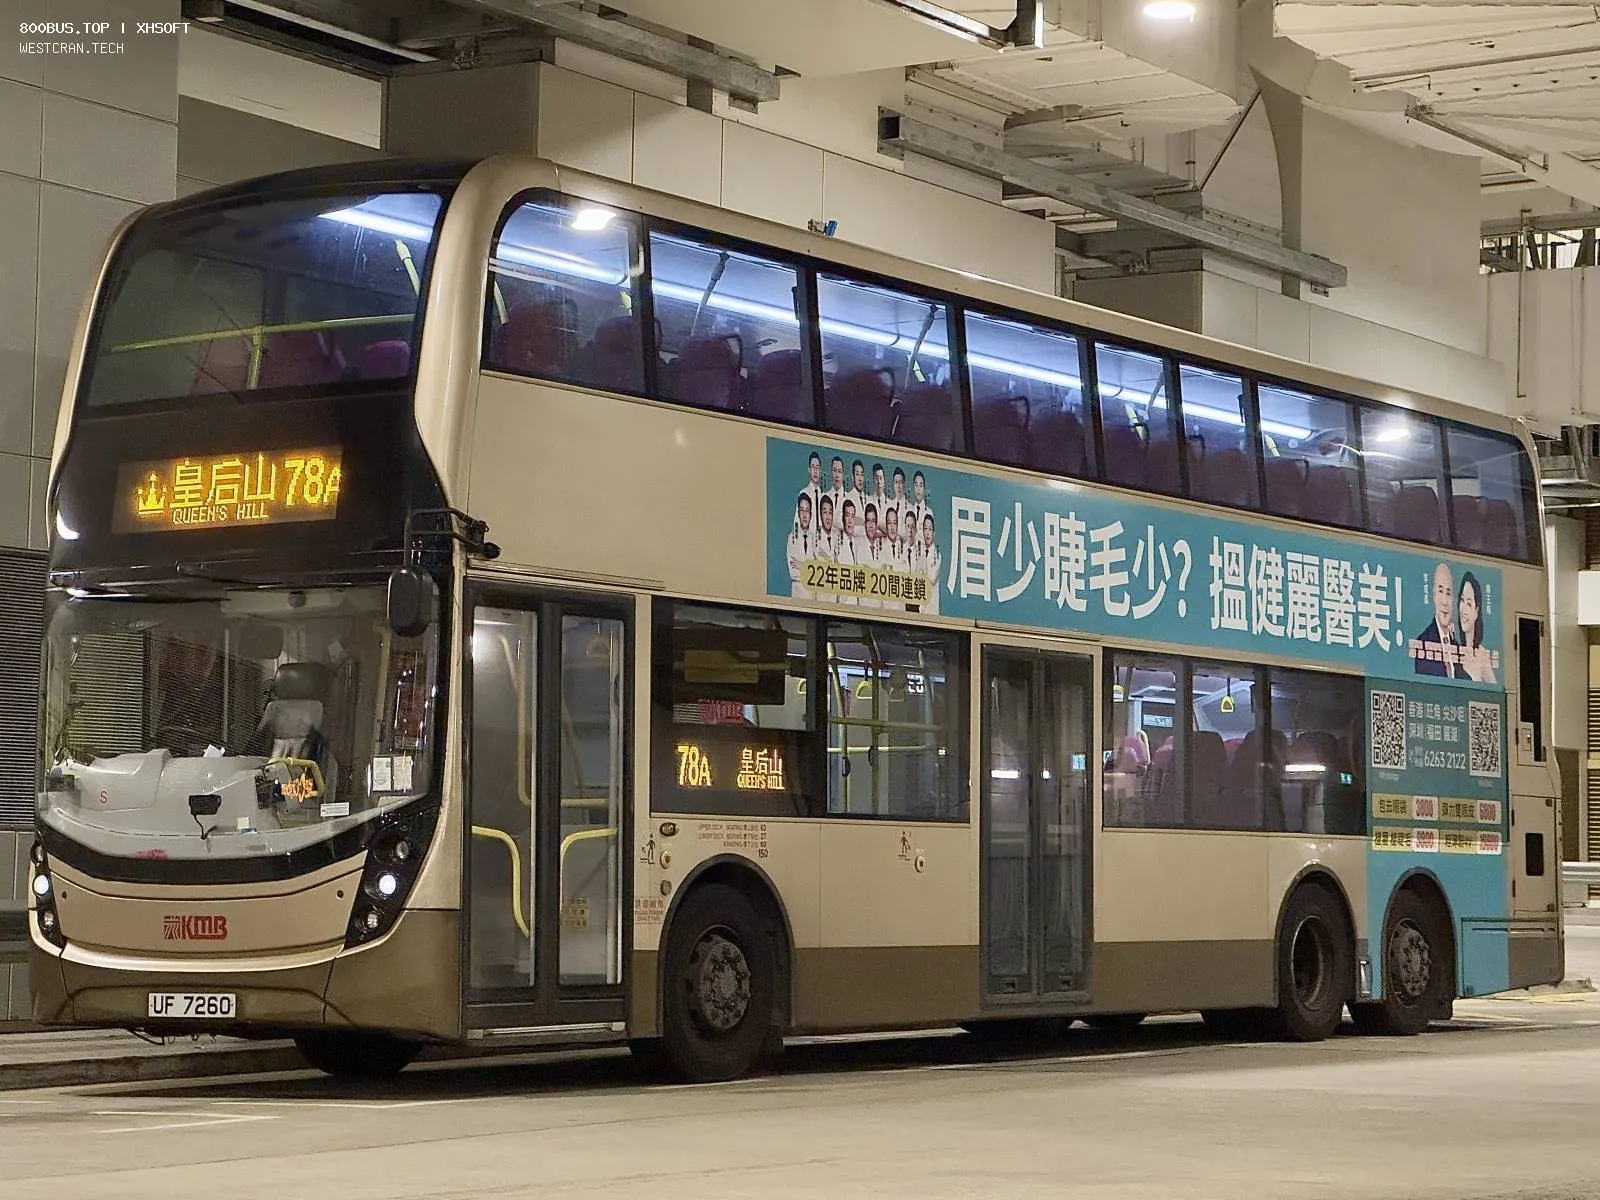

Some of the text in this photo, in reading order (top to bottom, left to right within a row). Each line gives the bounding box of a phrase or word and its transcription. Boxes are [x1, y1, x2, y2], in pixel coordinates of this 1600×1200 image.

[169, 452, 341, 508] 皇后山 78A
[172, 502, 269, 525] QUEEN'S HILL
[807, 564, 927, 601] 22年品牌 20間連鎖
[677, 744, 712, 787] 78A
[740, 747, 783, 775] 皇后山
[1424, 751, 1445, 768] 6263
[1447, 753, 1467, 770] 2122
[99, 790, 108, 804] S
[181, 915, 228, 940] KMB
[153, 995, 231, 1015] UF 7260
